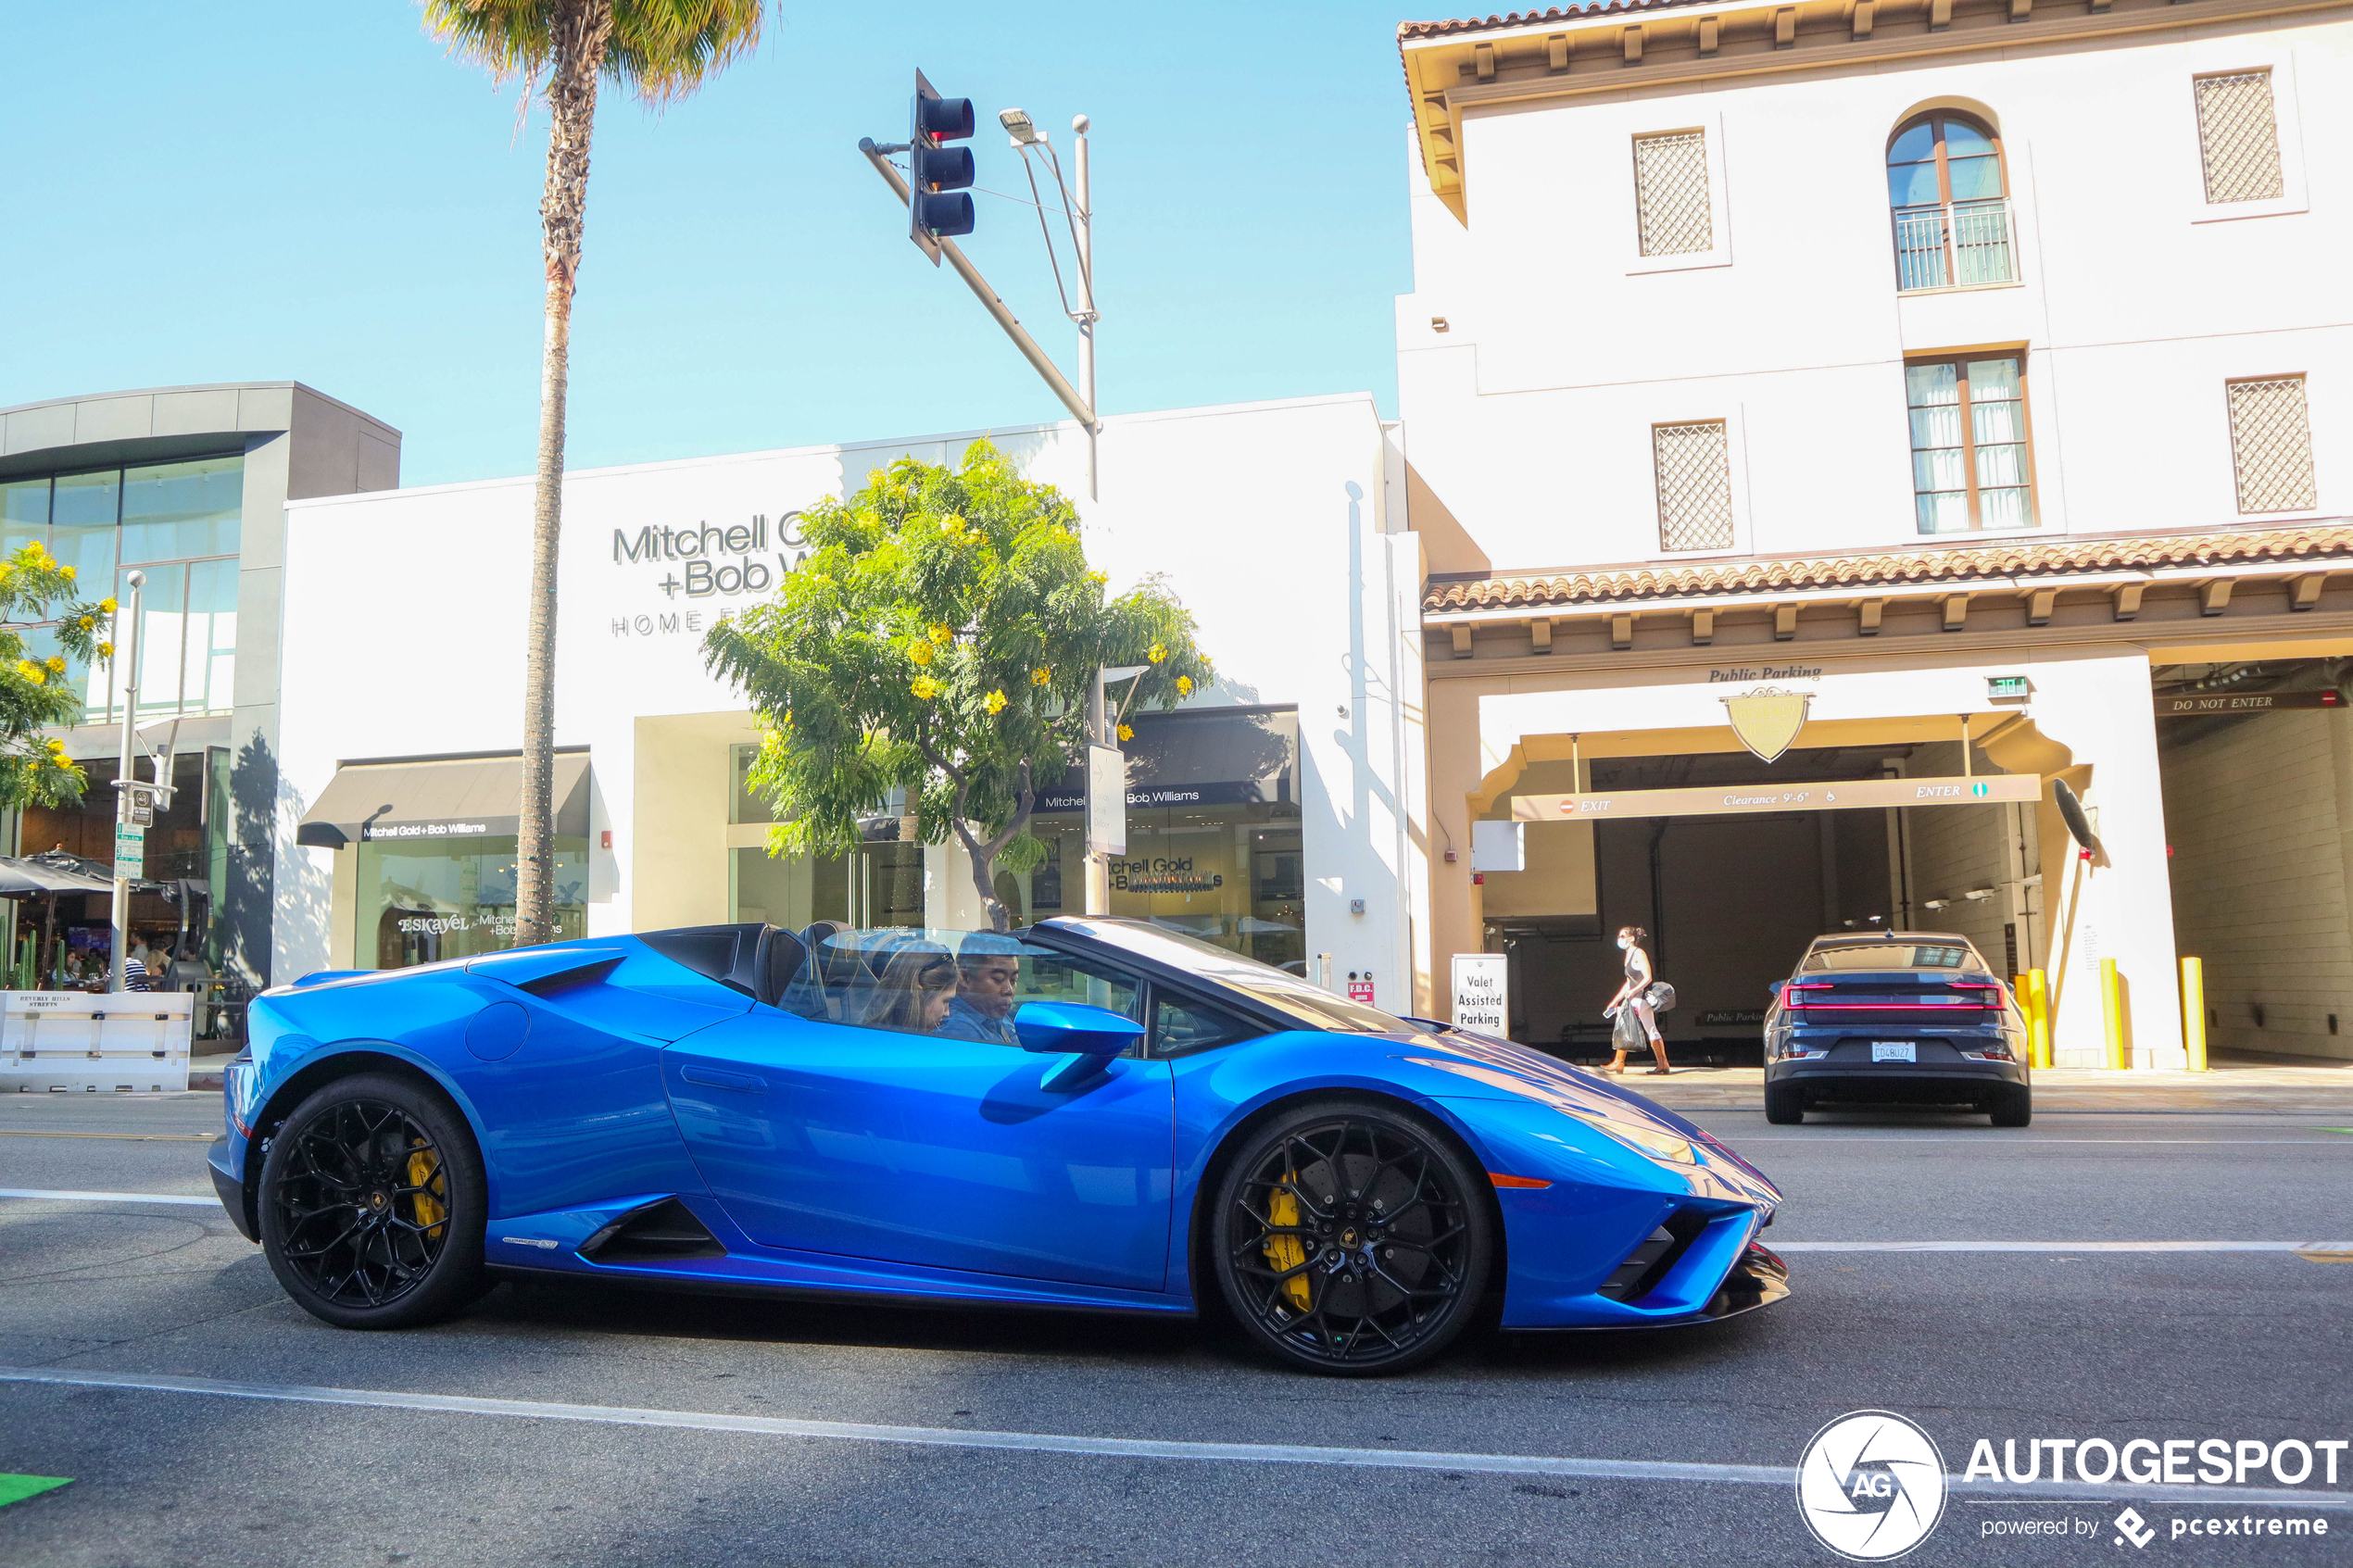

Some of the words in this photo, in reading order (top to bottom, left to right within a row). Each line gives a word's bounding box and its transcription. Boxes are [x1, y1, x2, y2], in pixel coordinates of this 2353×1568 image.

[613, 514, 768, 563] Mitchell
[611, 610, 701, 638] HOME
[1708, 668, 1756, 683] Public
[1762, 665, 1822, 682] Parking
[2173, 700, 2193, 710] DO
[2199, 698, 2226, 709] NOT
[2231, 696, 2272, 708] ENTER
[1739, 705, 1795, 720] BEVERLY
[1749, 721, 1787, 735] HILLS
[1045, 796, 1086, 808] Mitchel
[1126, 793, 1151, 803] Bob
[1151, 791, 1200, 803] Williams
[1580, 800, 1611, 812] EXIT
[1723, 794, 1778, 806] Clearance
[1916, 785, 1961, 798] ENTER
[1093, 803, 1107, 815] Drive
[363, 826, 397, 837] Mitchell
[398, 825, 421, 836] Gold
[427, 824, 447, 834] Bob
[447, 823, 486, 834] Williams
[1152, 857, 1192, 872] Gold
[479, 914, 517, 925] Mitchel
[1466, 975, 1492, 987] Valet
[1350, 985, 1373, 993] F.D.C.
[1458, 994, 1502, 1006] Assisted
[1460, 1012, 1500, 1027] Parking
[1706, 1012, 1733, 1022] Public
[1736, 1012, 1764, 1022] Parkin
